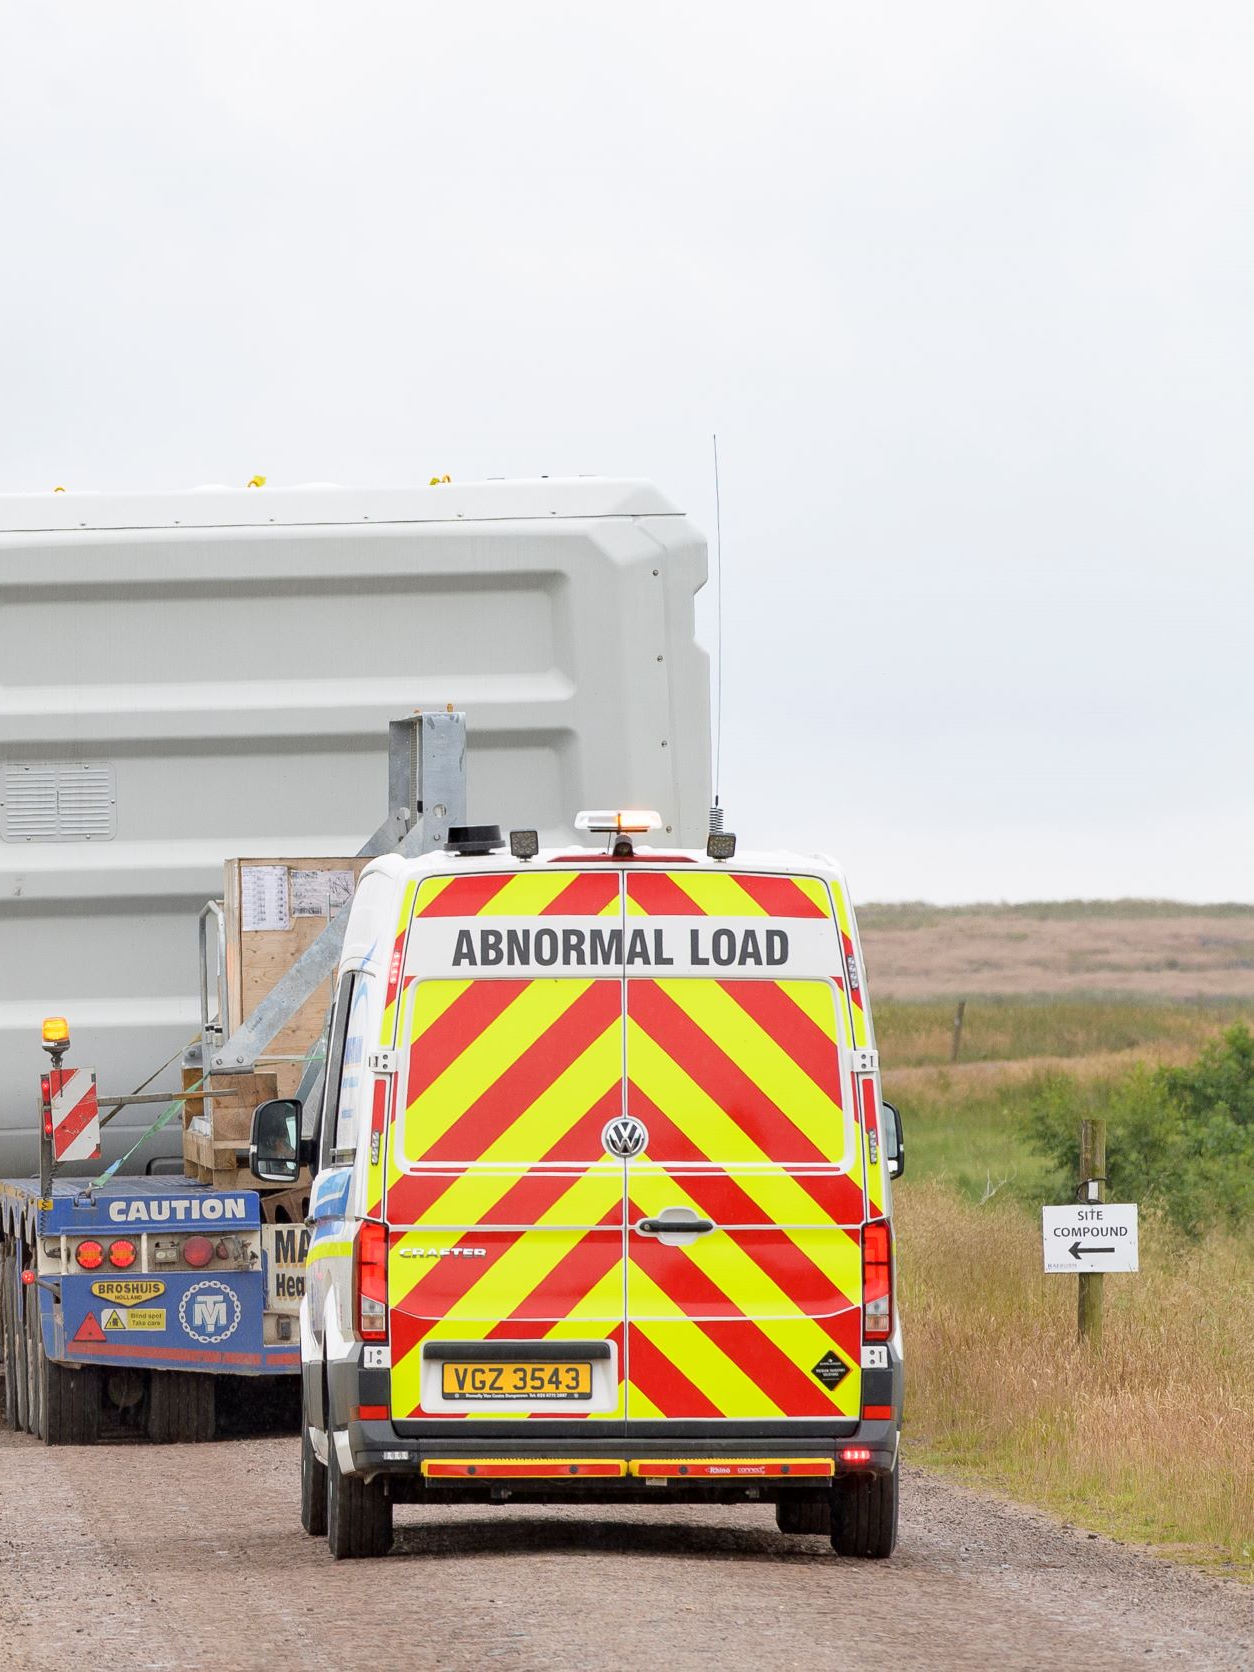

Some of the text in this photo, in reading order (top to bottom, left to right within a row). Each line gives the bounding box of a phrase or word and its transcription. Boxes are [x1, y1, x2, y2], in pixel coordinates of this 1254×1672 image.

[452, 928, 789, 966] ABNORMAL LOAD
[109, 1198, 246, 1222] CAUTION
[1077, 1210, 1104, 1221] SITE
[1053, 1226, 1128, 1238] COMPOUND
[399, 1248, 487, 1259] CRAFTER
[98, 1283, 161, 1294] BROSHUIS
[276, 1273, 306, 1297] Hea
[454, 1367, 580, 1391] VGZ 3543
[709, 1466, 731, 1474] Rhino
